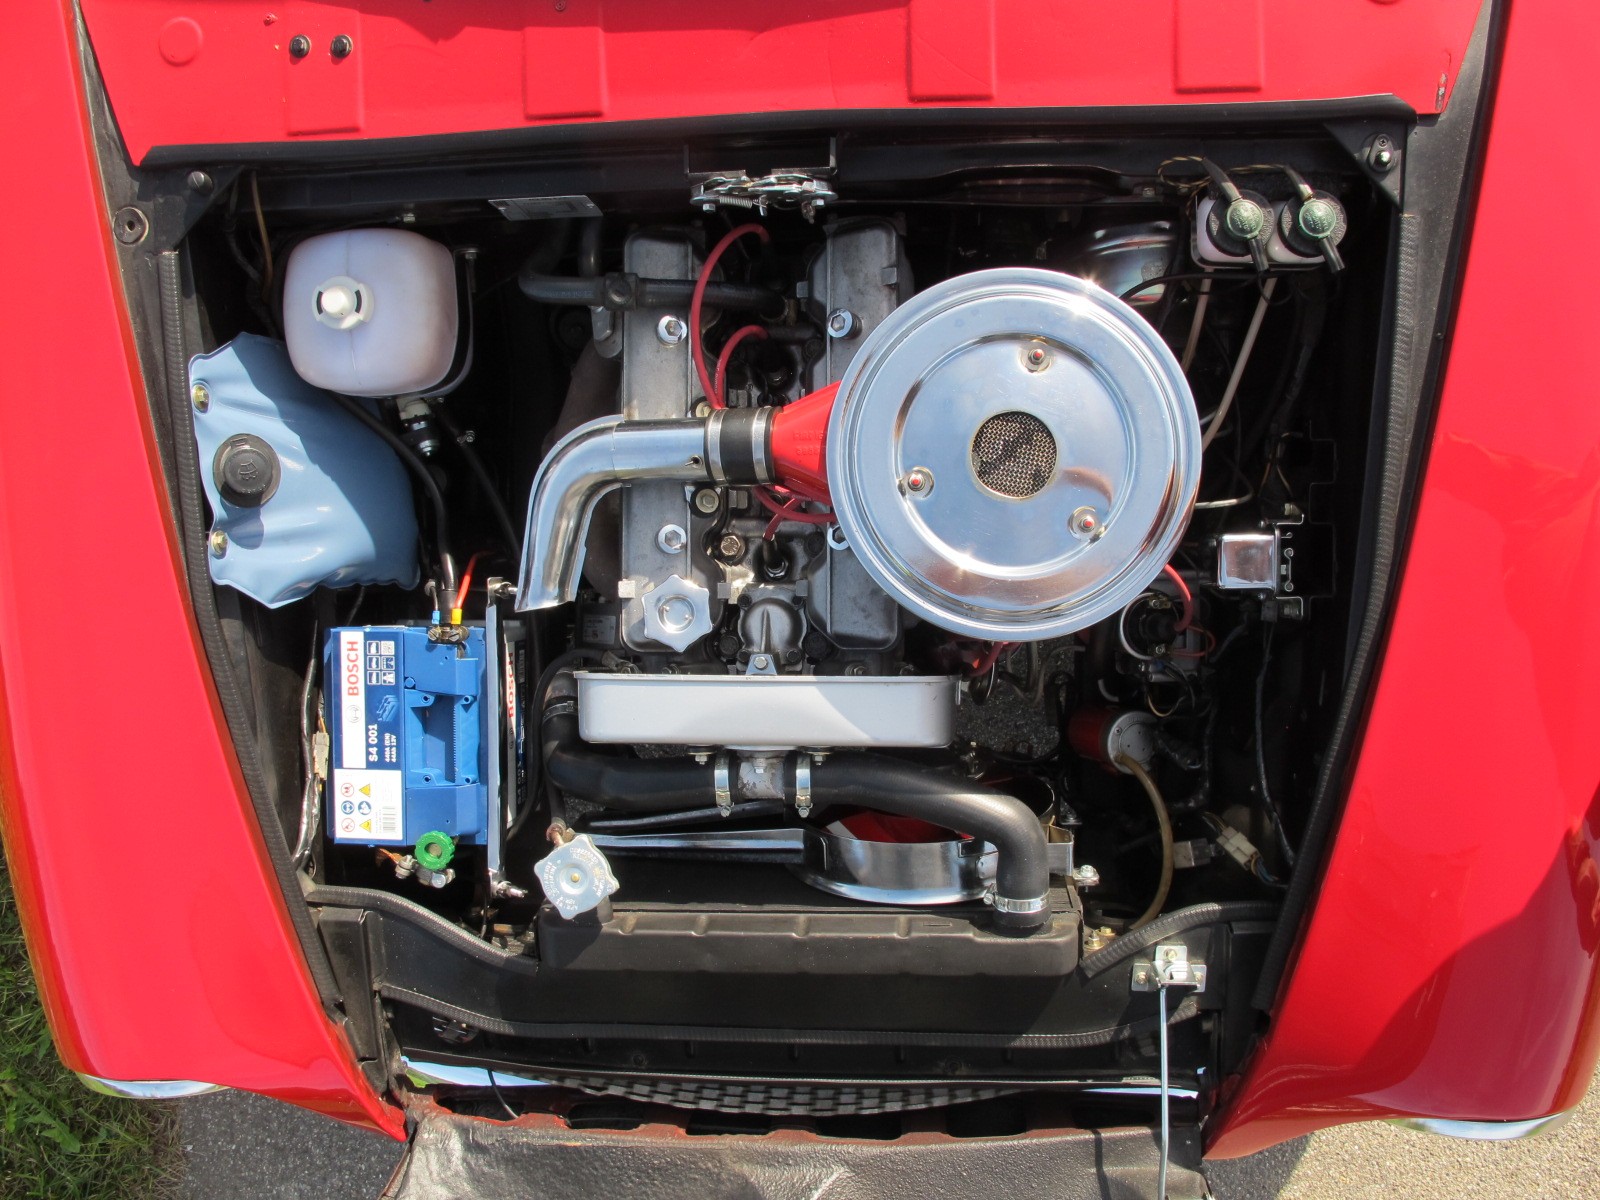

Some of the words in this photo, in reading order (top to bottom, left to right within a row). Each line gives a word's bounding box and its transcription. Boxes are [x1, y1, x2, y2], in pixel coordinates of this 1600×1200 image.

[346, 641, 360, 696] BOSCH
[368, 723, 378, 744] 001
[368, 747, 379, 762] S4
